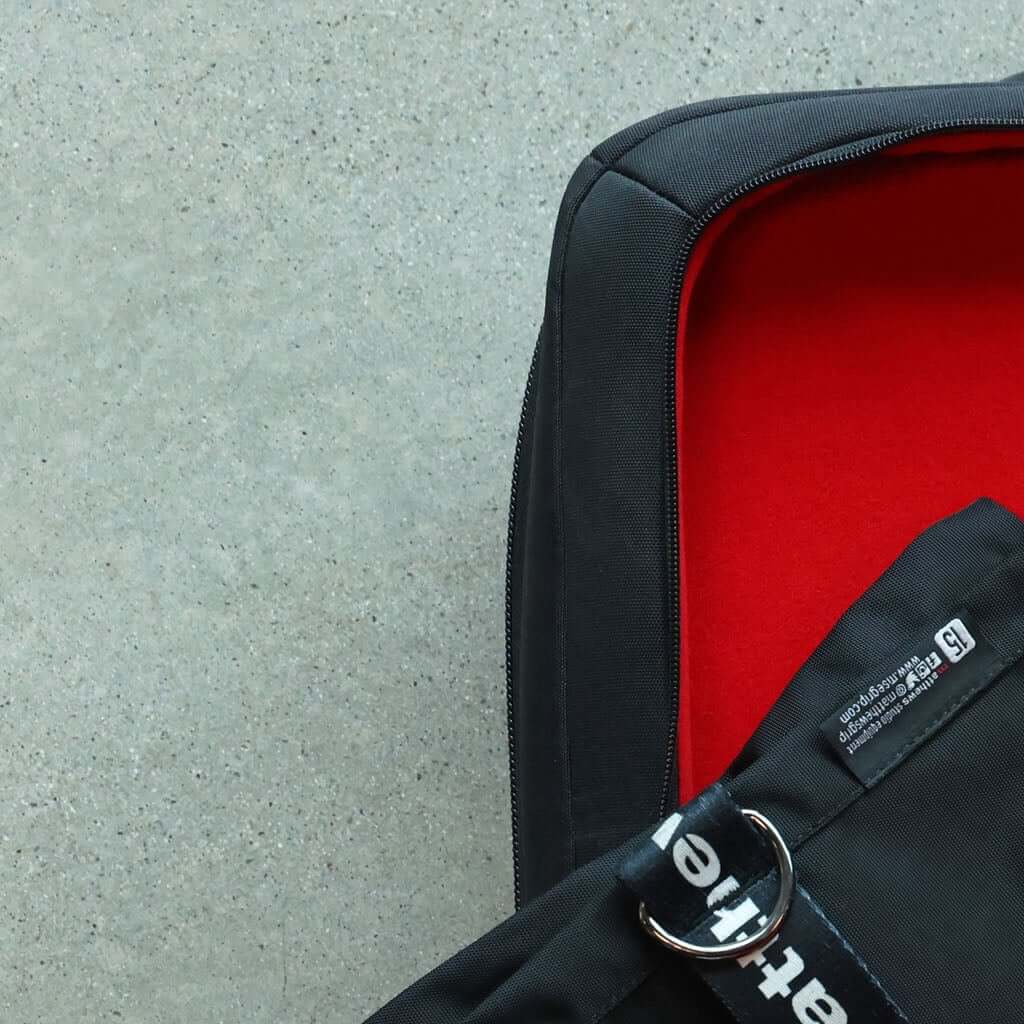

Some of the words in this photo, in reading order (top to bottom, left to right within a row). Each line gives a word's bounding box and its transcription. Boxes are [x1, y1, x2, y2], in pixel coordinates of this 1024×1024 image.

[942, 626, 968, 657] 15
[839, 655, 921, 724] www.msegrip.com
[902, 664, 949, 706] matthews
[839, 683, 907, 743] @matthewsgrip
[881, 704, 904, 726] studio
[846, 722, 883, 755] equipment
